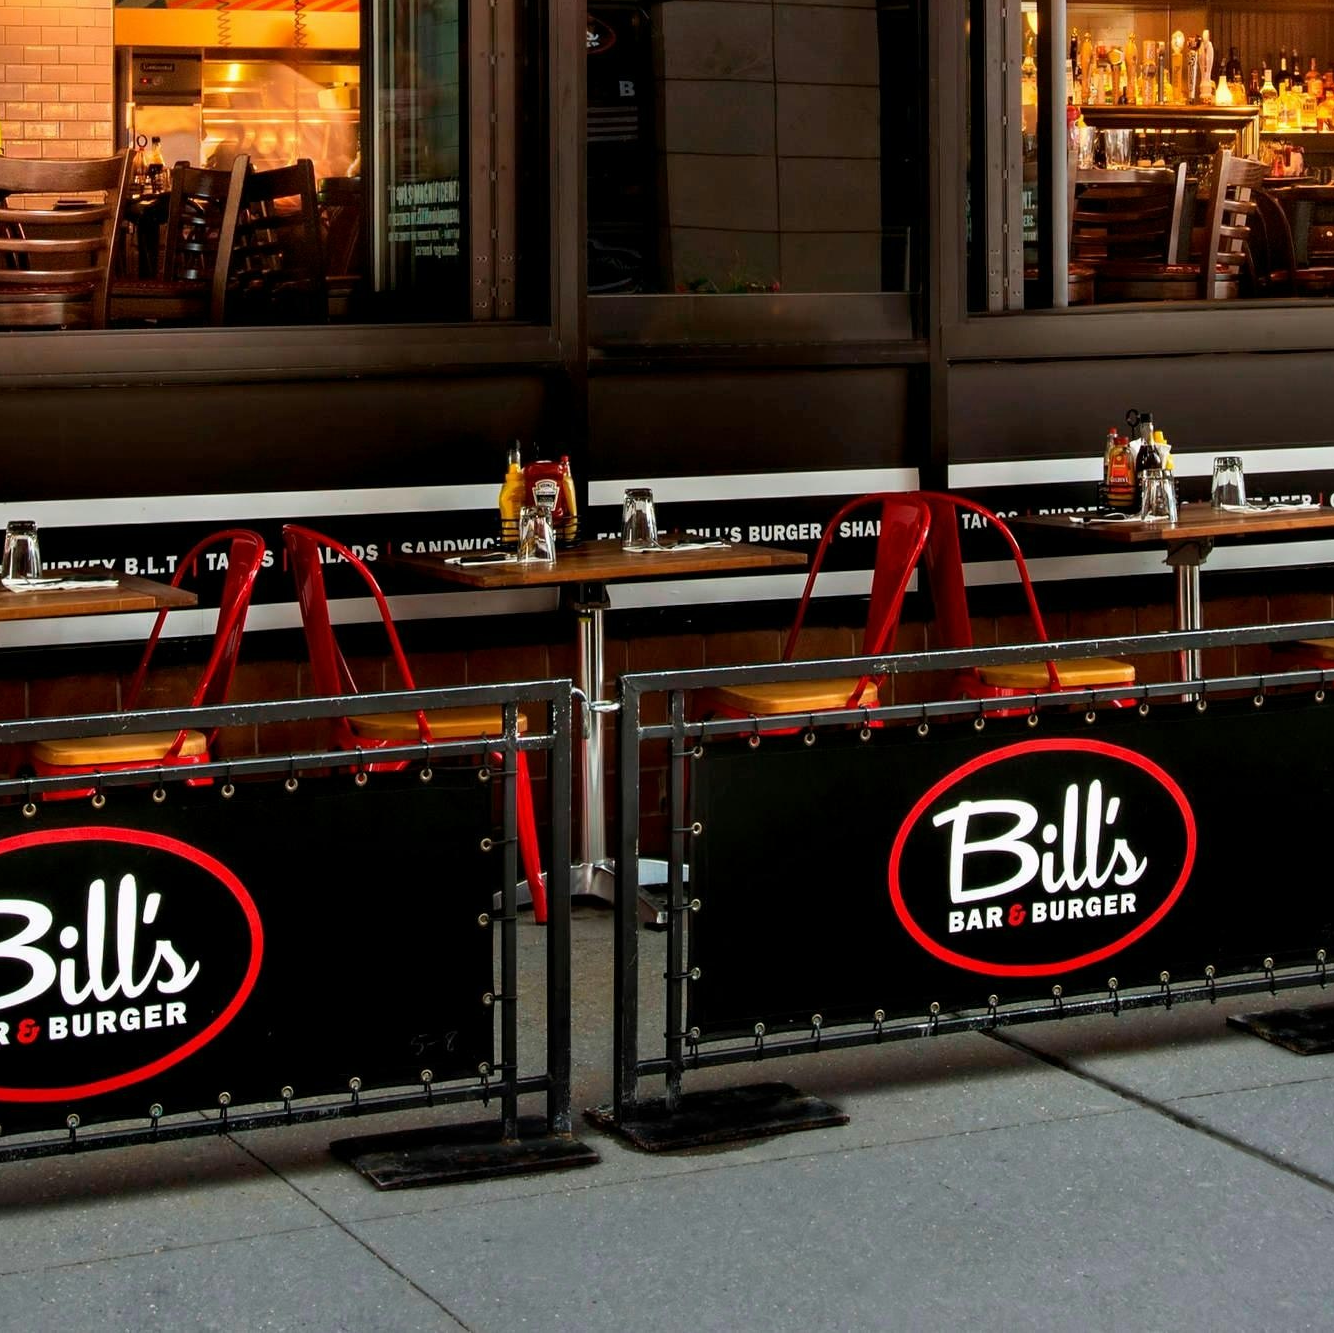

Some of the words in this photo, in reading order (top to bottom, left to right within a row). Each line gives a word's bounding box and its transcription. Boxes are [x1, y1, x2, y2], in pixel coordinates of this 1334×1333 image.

[748, 522, 822, 543] BURGER
[839, 519, 882, 538] SHA
[317, 544, 378, 564] ALADS
[932, 779, 1148, 904] Bill's
[948, 906, 1004, 933] BAR
[1007, 904, 1027, 927] &
[1031, 892, 1137, 924] BURGER
[15, 1018, 41, 1045] &
[48, 1001, 188, 1041] BURGER
